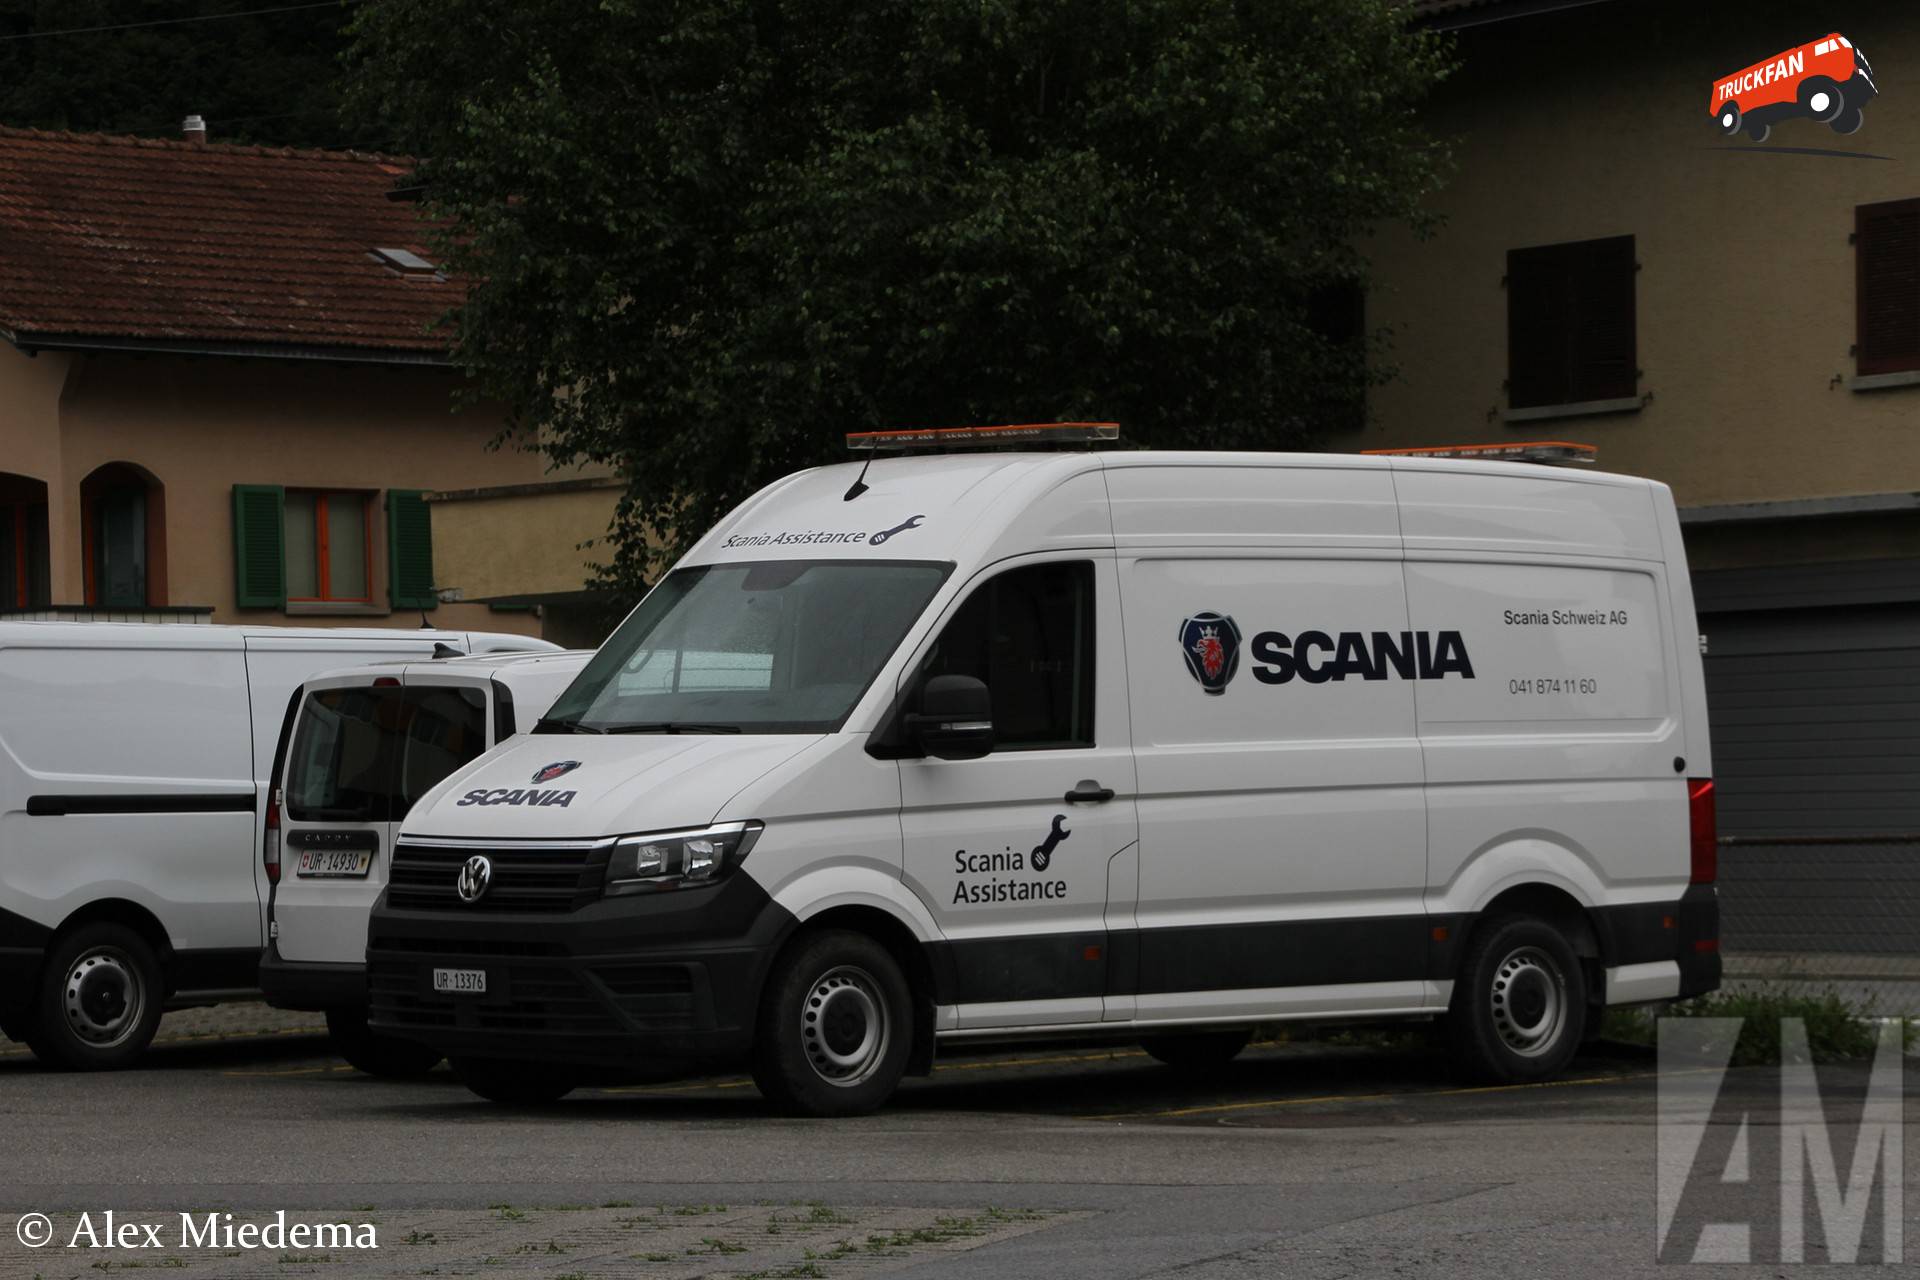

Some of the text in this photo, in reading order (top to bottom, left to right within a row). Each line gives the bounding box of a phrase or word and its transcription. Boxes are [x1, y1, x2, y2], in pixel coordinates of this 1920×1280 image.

[721, 529, 867, 549] Scania Assistance
[1503, 609, 1628, 625] Scania Schweiz AG
[1251, 630, 1476, 684] SCANIA
[1509, 678, 1597, 695] 041 874 11 60
[456, 789, 578, 808] SCANIA
[954, 846, 1024, 874] Scania
[952, 877, 1067, 905] Assistance
